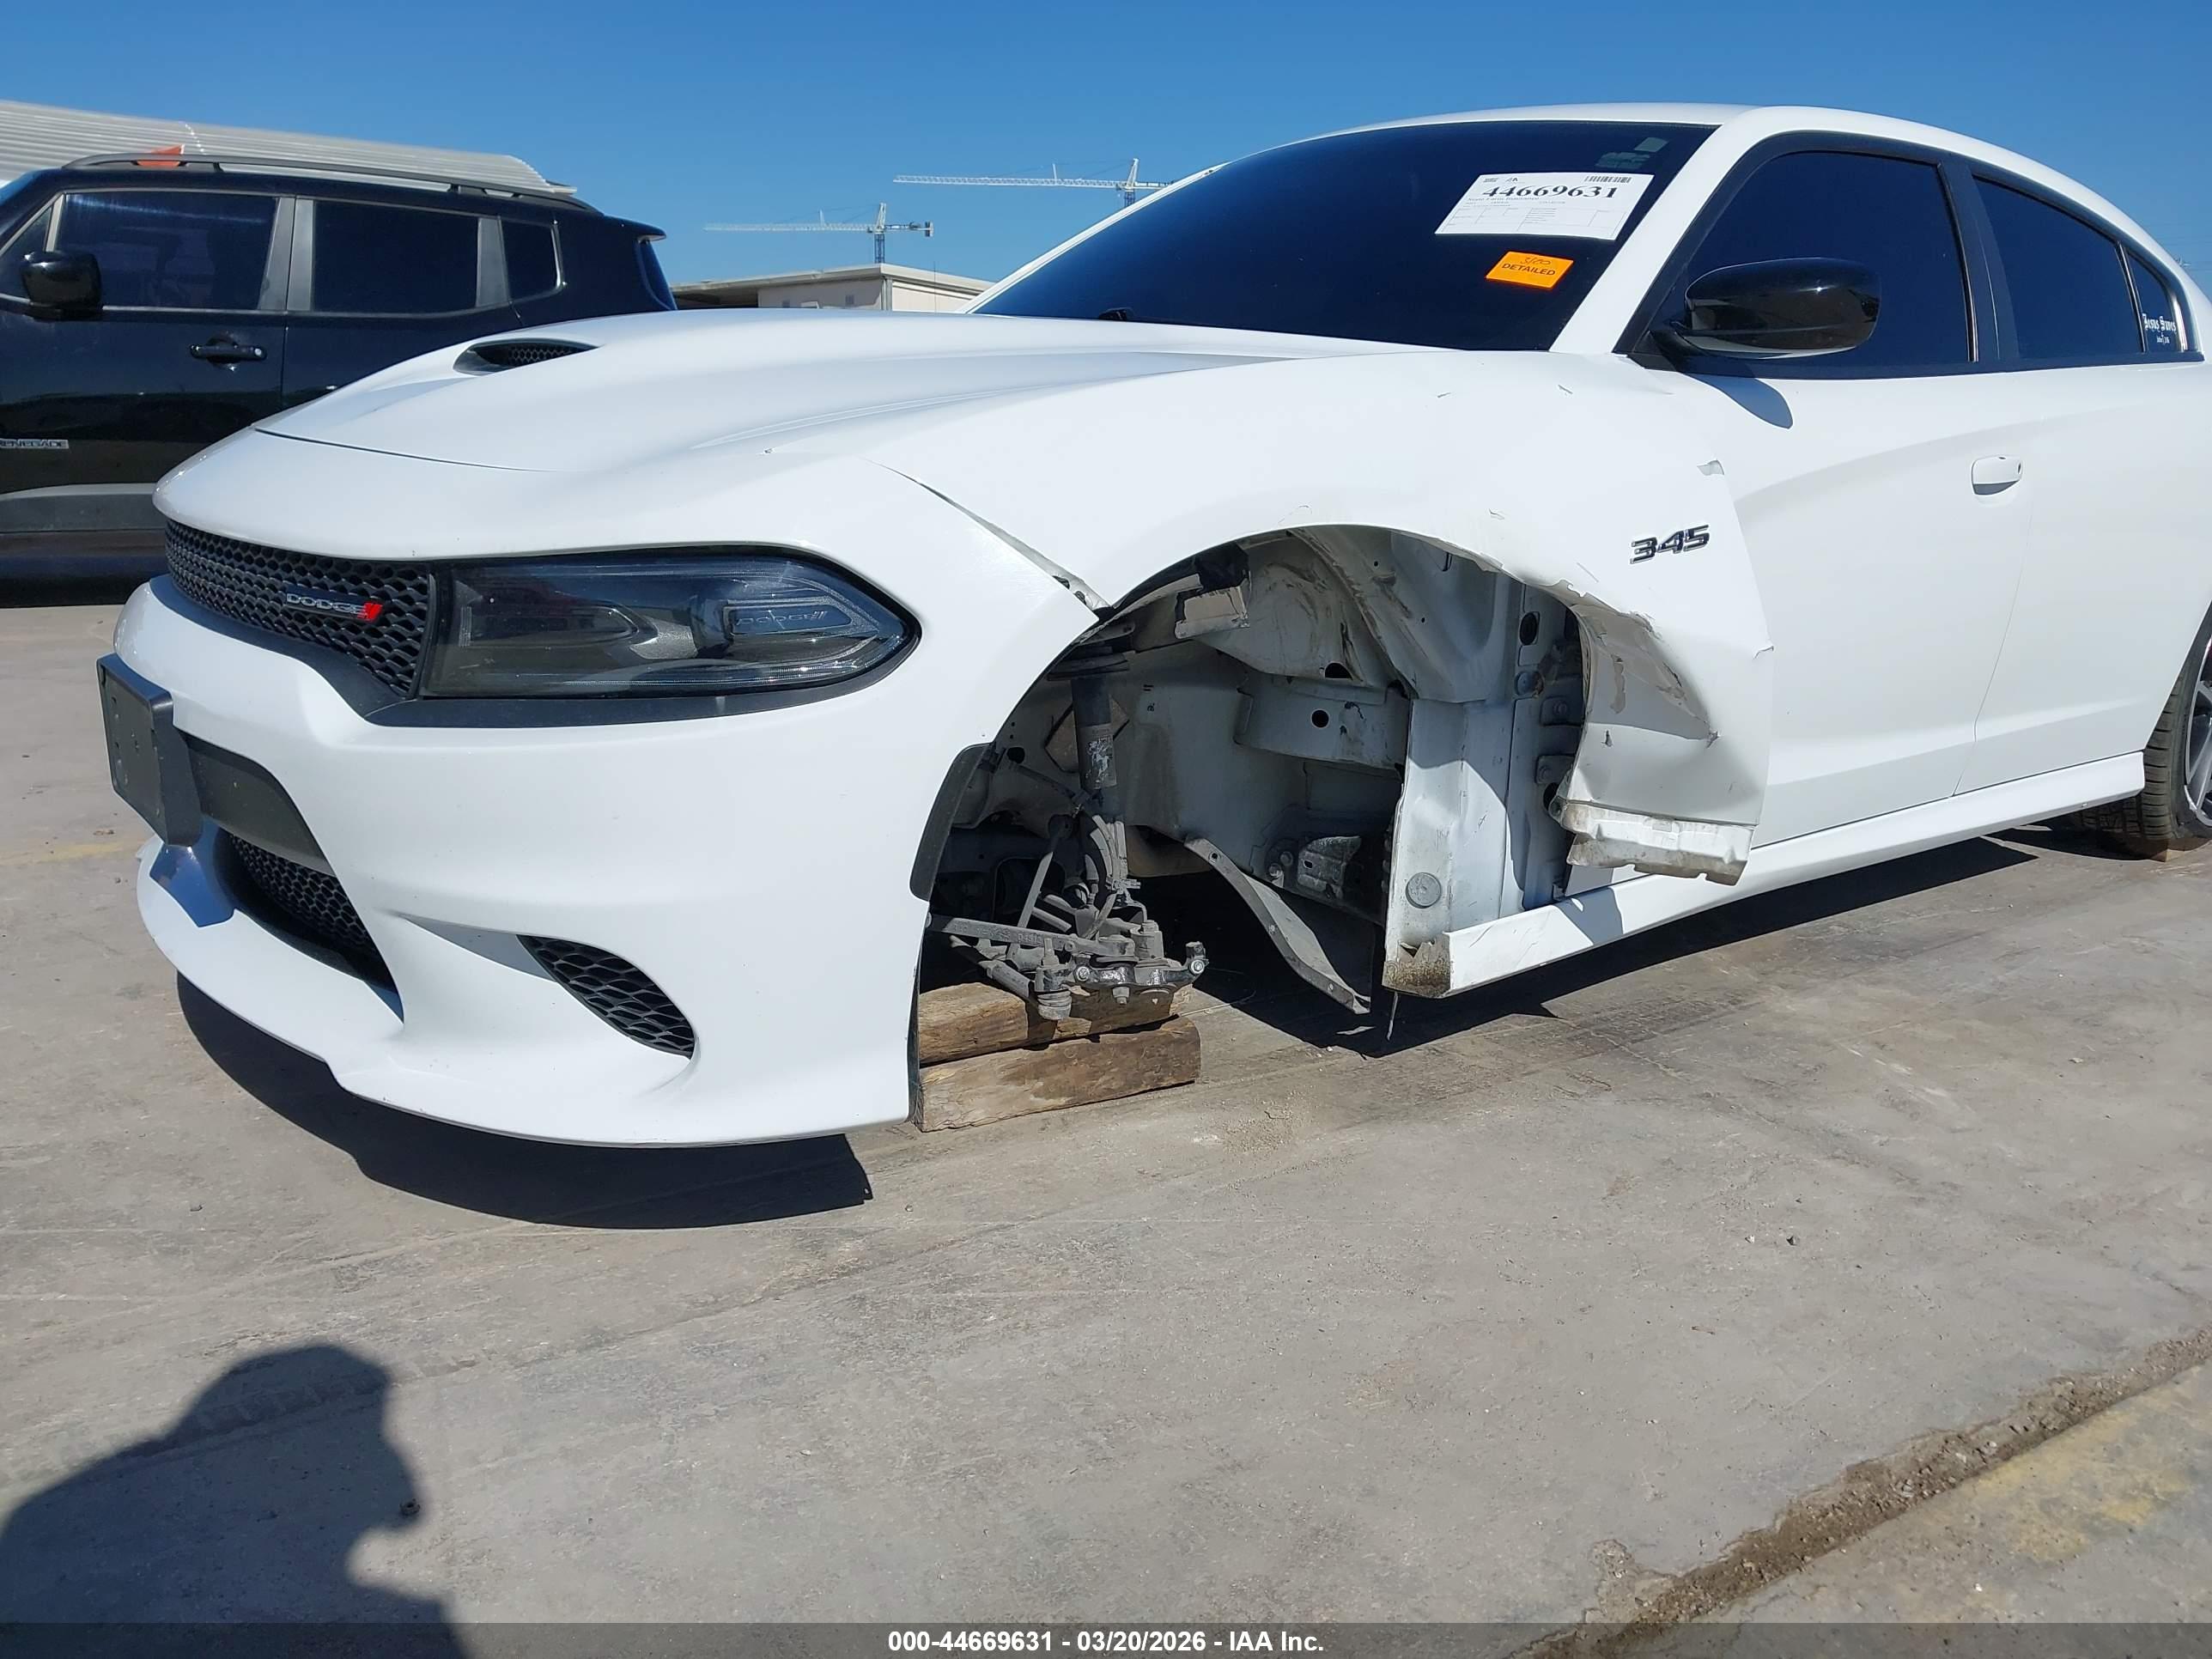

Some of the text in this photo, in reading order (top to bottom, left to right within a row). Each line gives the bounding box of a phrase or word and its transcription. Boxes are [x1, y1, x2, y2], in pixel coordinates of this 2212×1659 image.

[1481, 185, 1618, 199] 44669631
[1501, 263, 1556, 276] DETAILED
[1630, 525, 1710, 564] 345
[286, 592, 366, 615] DODGE
